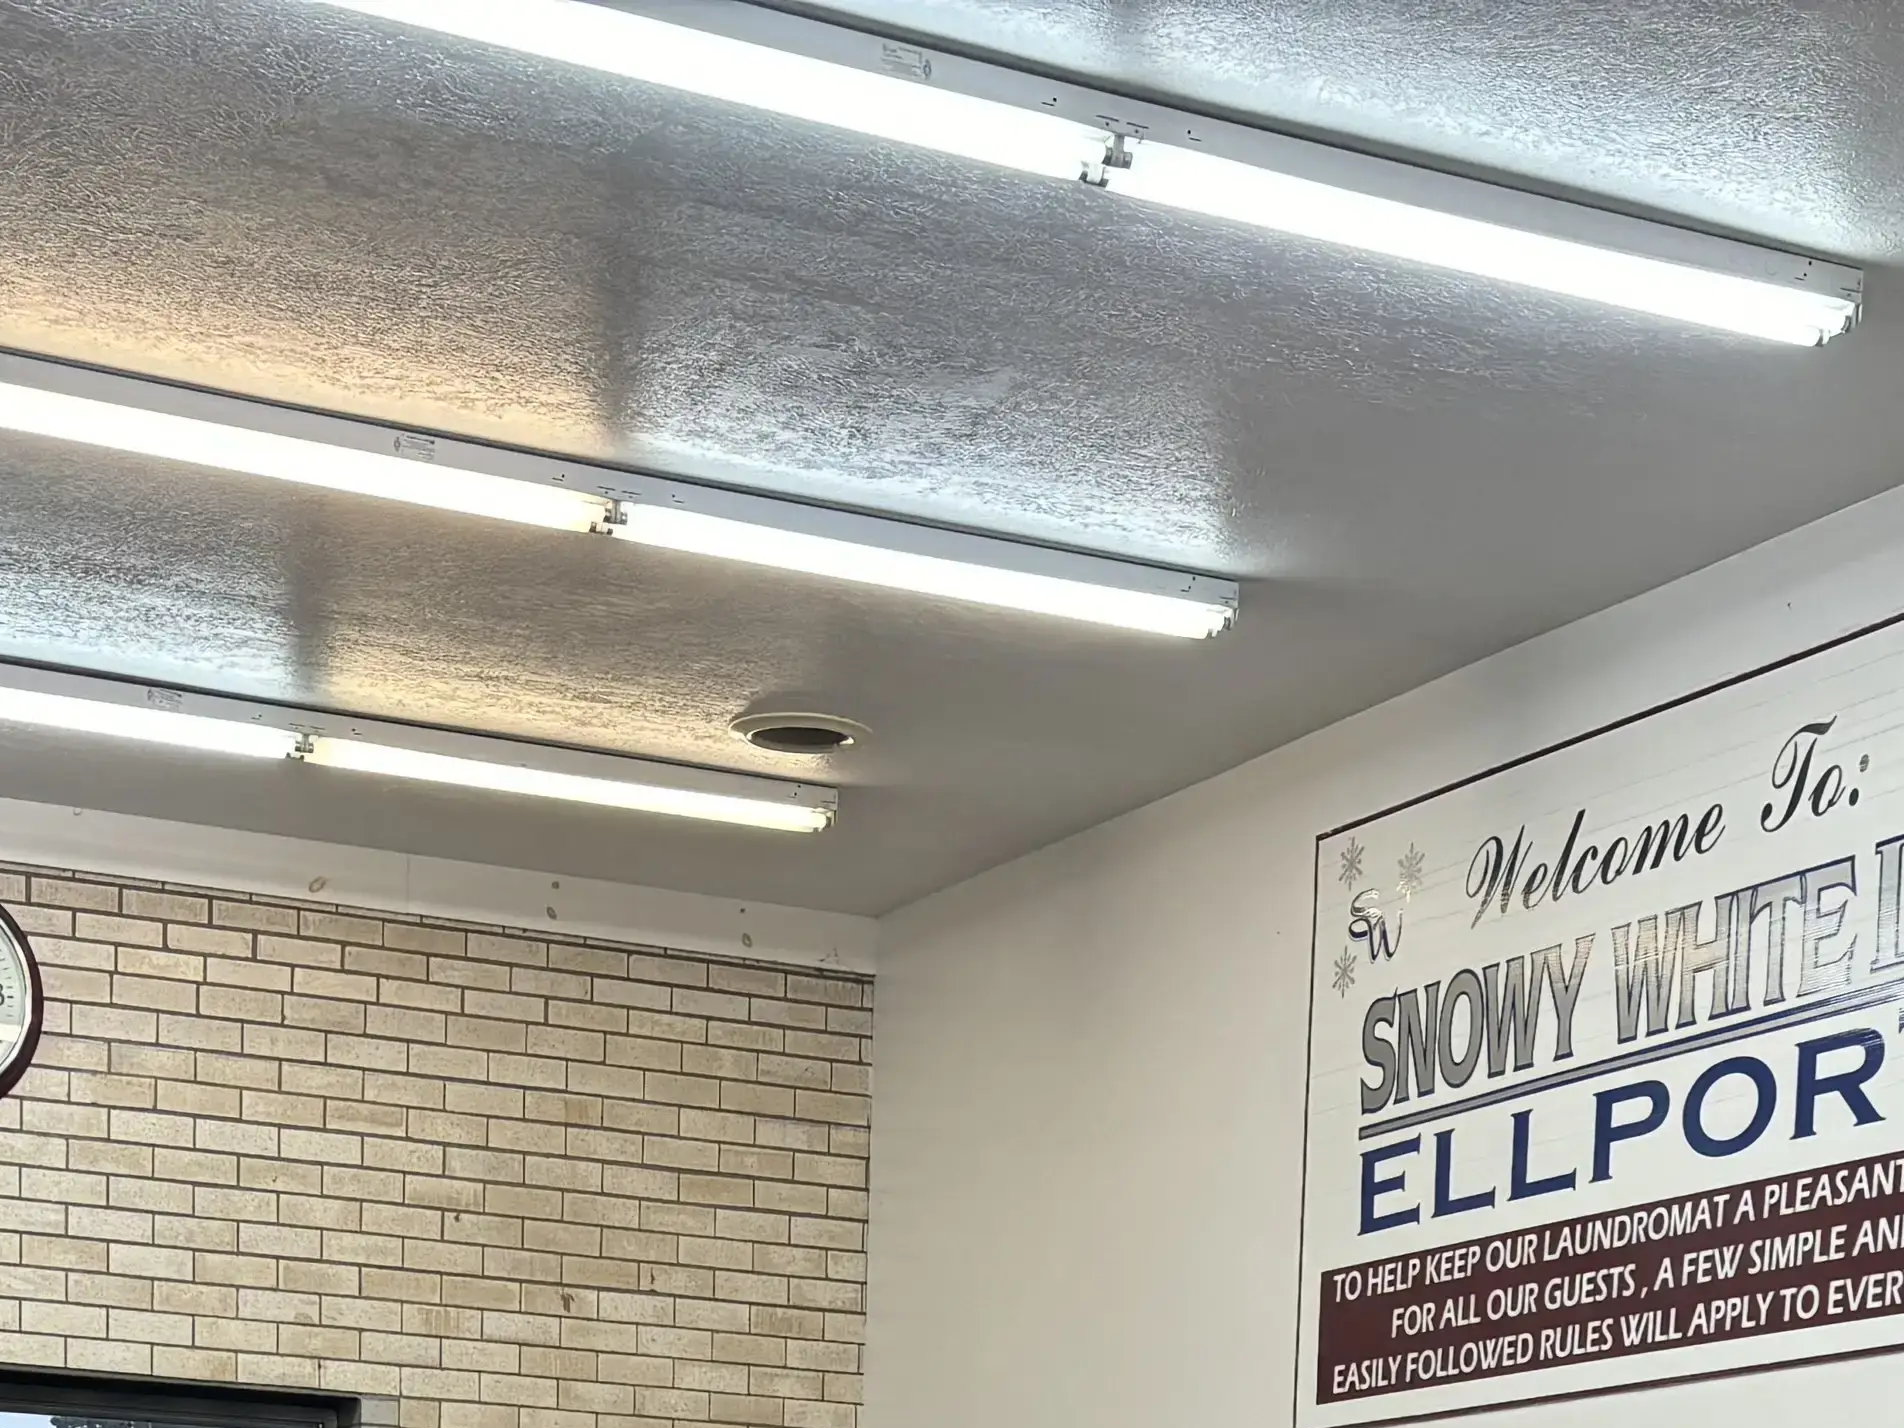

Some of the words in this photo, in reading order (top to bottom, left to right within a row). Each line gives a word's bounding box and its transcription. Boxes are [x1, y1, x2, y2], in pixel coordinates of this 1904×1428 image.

[1466, 803, 1727, 930] Welcome
[1761, 716, 1870, 832] To:
[1360, 938, 1594, 1114] SNOWY
[1613, 856, 1859, 1045] WHITE
[1333, 1271, 1361, 1302] TO
[1367, 1258, 1420, 1296] HELP
[1425, 1246, 1480, 1284] KEEP
[1486, 1234, 1537, 1272] OUR
[1544, 1194, 1730, 1261] LAUNDROMAT
[1392, 1302, 1435, 1337] FOR
[1440, 1295, 1481, 1329] ALL
[1487, 1283, 1538, 1320] OUR
[1682, 1244, 1744, 1286] FEW
[1748, 1225, 1847, 1274] SIMPLE
[1333, 1355, 1401, 1394] EASILY
[1406, 1333, 1533, 1382] FOLLOWED
[1540, 1318, 1613, 1360] RULES
[1621, 1308, 1682, 1346] WILL
[1687, 1291, 1774, 1336] APPLY
[1780, 1285, 1819, 1321] TO
